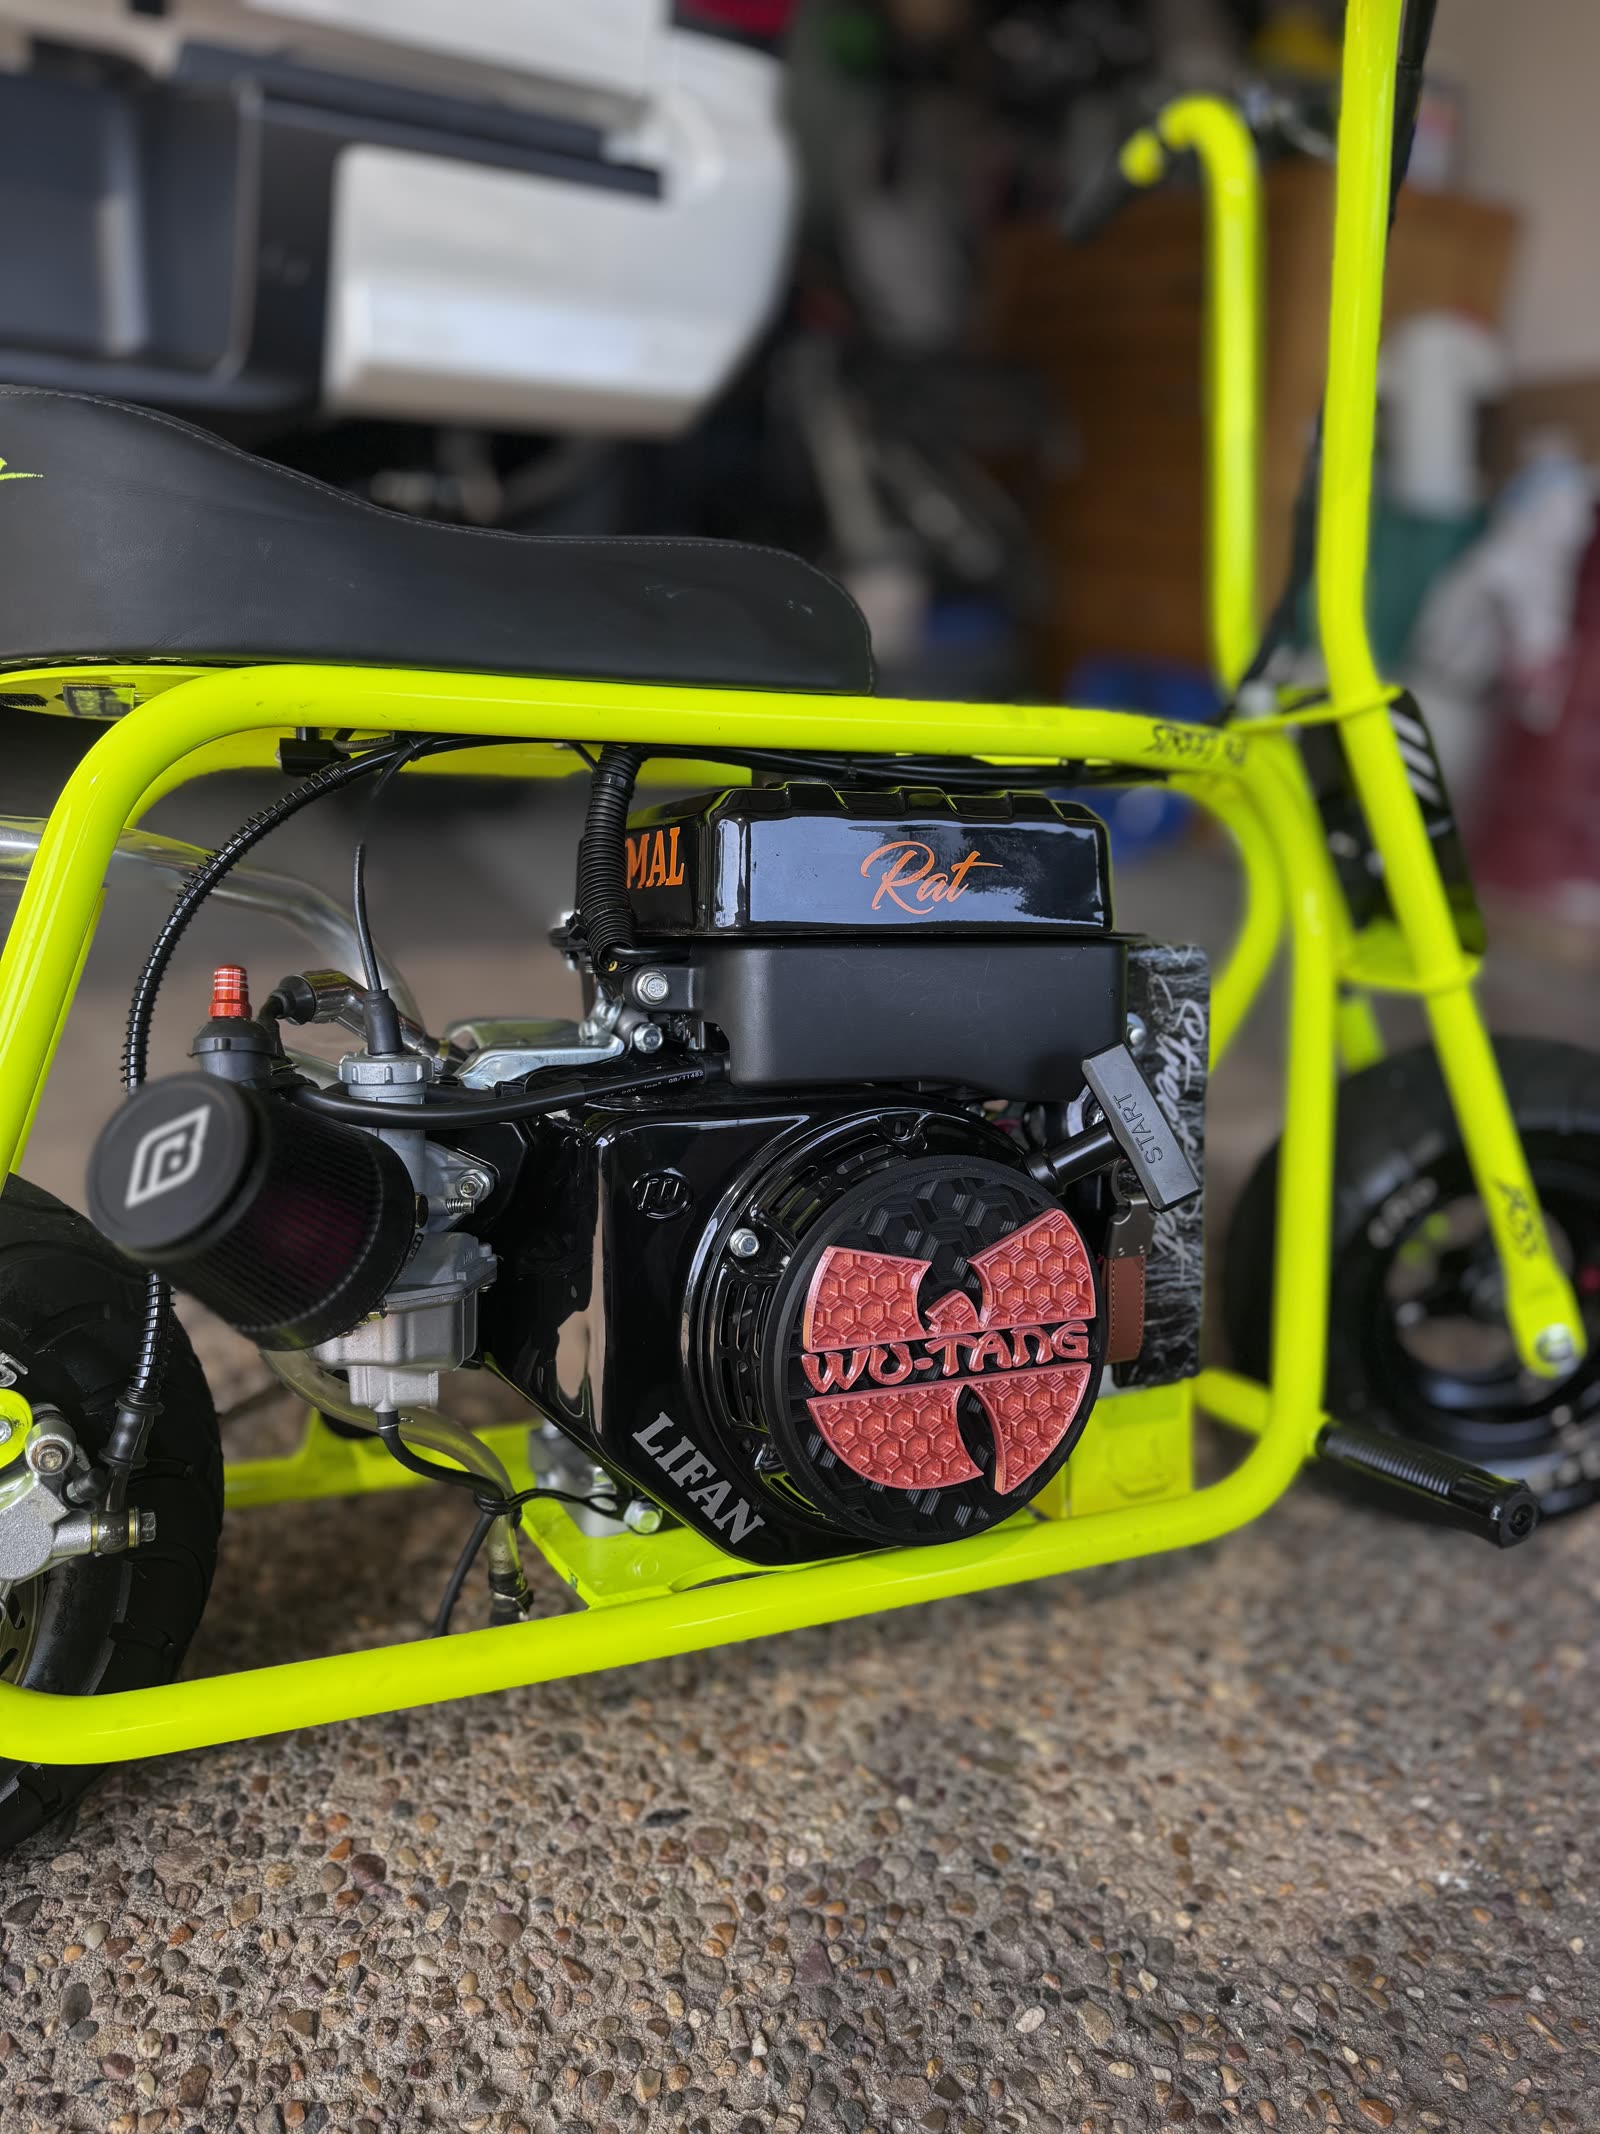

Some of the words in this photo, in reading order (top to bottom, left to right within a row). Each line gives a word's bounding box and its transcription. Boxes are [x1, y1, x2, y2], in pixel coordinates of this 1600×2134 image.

[860, 841, 1003, 914] Rat
[1113, 1093, 1163, 1164] START
[801, 1321, 1088, 1393] WU-TANG
[632, 1411, 766, 1544] LIFAN
